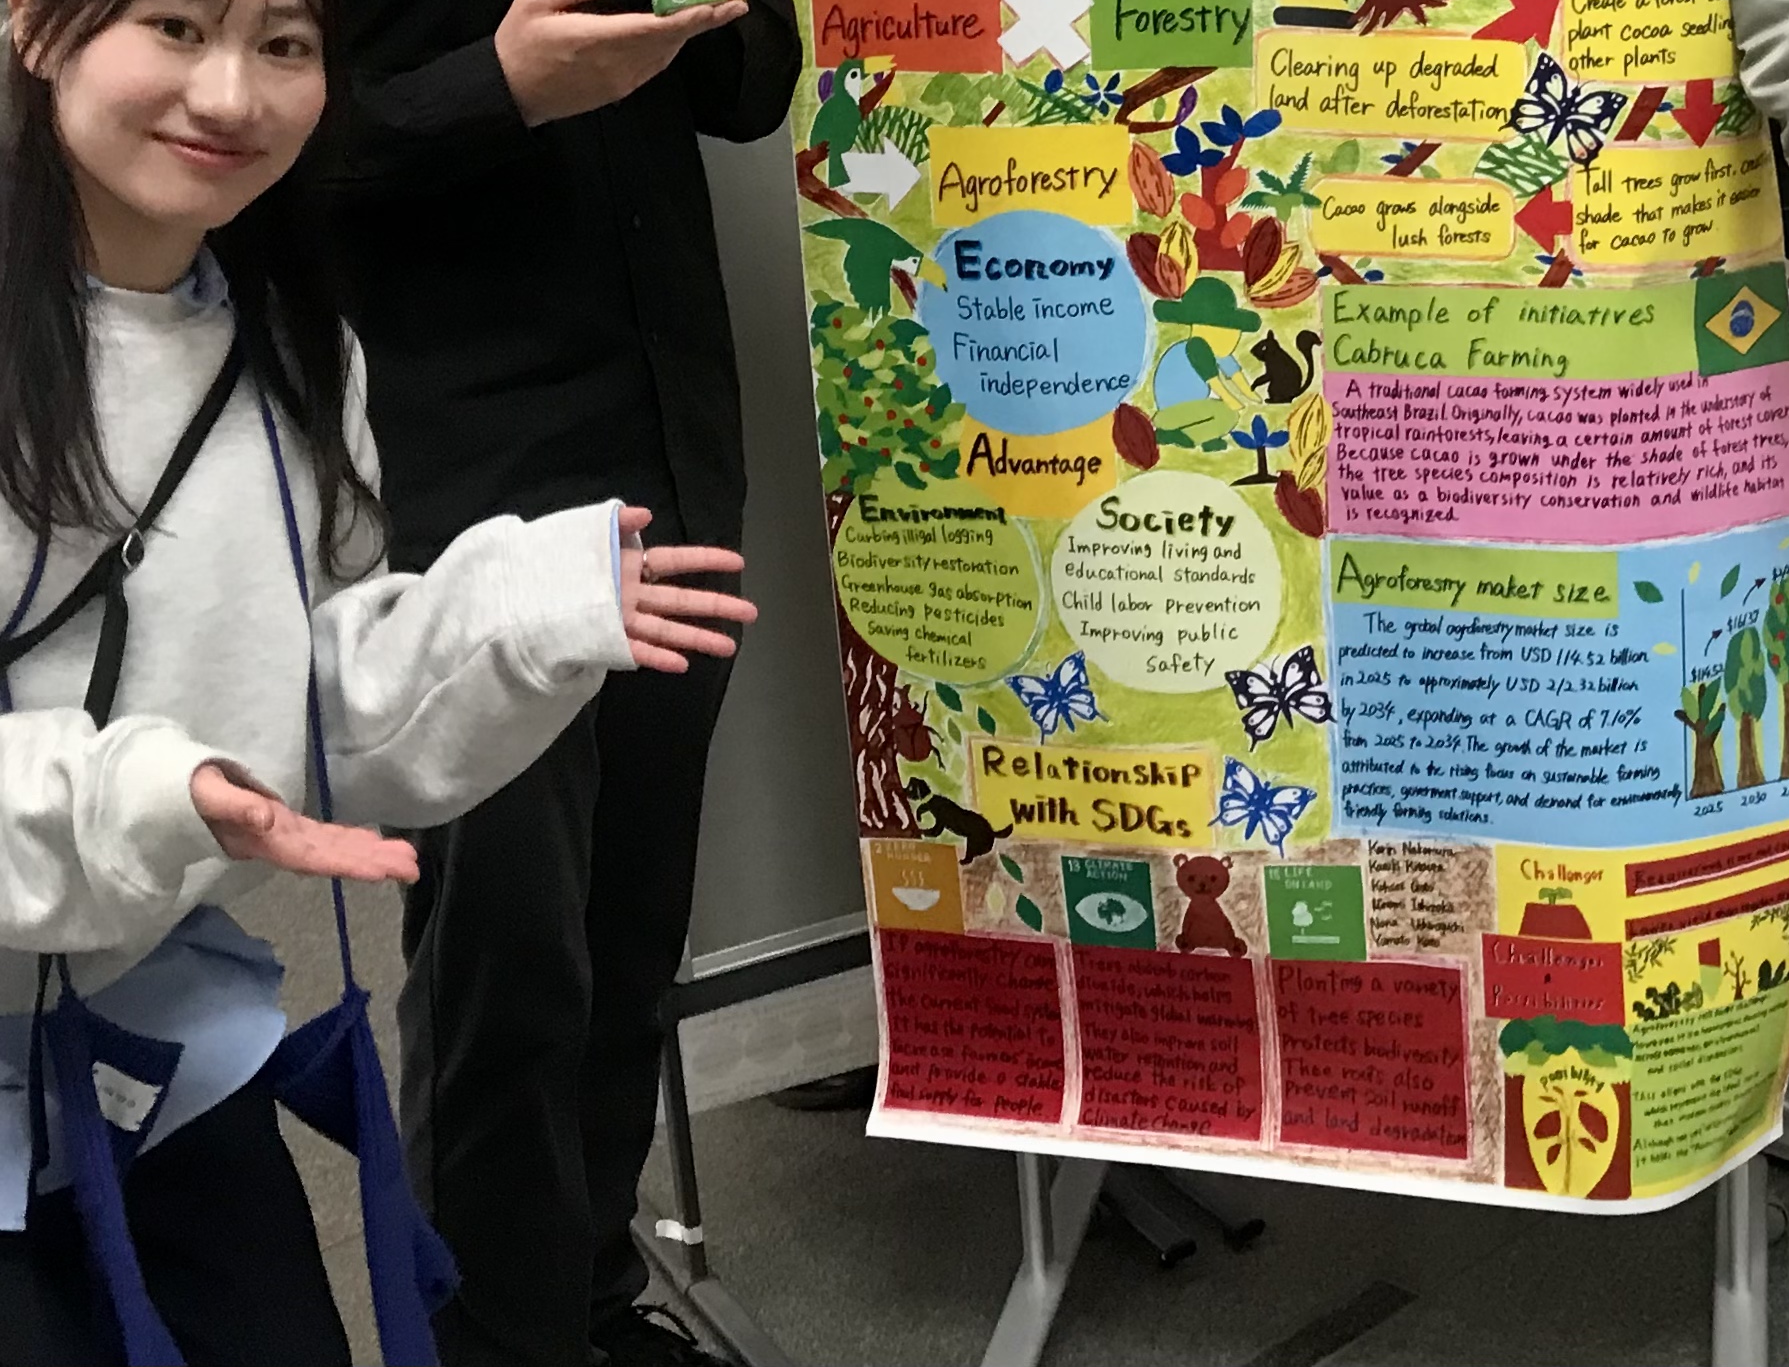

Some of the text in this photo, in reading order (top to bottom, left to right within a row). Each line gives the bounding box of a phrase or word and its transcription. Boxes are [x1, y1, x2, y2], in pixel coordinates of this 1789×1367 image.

[821, 3, 984, 58] Agriculture
[1569, 18, 1612, 51] plant
[1620, 24, 1673, 42] cocoa
[1270, 47, 1499, 92] Clearing up degraded
[1569, 45, 1676, 76] other plants
[1269, 83, 1508, 122] land after deforestation
[938, 157, 1118, 213] Agroforestry
[1576, 167, 1701, 197] Tall trees grow
[1323, 192, 1501, 231] Cacao grows alongside
[1576, 194, 1712, 225] shade that makes
[1392, 224, 1490, 249] lush forests
[1578, 229, 1656, 254] for cacao
[954, 239, 1115, 282] Economy
[957, 294, 1115, 322] Stable income
[1333, 289, 1655, 332] Example of initiatives
[953, 332, 1059, 363] Financial
[1333, 333, 1569, 378] Cabruca Farming
[980, 372, 1130, 398] independence
[1369, 371, 1693, 407] traditional cacao system widely used
[1332, 401, 1696, 426] Southeast Originally, cacao was planted the
[1334, 414, 1753, 446] tropical rainforests, leaving certain amount forest
[966, 432, 1102, 486] Advantage
[1336, 438, 1748, 470] Because cacao grown under the shade forest
[1338, 456, 1755, 488] the tree species composition and
[1341, 481, 1739, 509] value as biodiversity conservation and wildlife
[1096, 496, 1234, 537] Society
[1366, 507, 1460, 525] recognized
[845, 526, 900, 545] Curbing
[942, 526, 994, 545] logging
[1068, 536, 1242, 562] Improving living and
[934, 556, 1019, 575] restoration
[1065, 561, 1255, 584] educational standards
[1337, 552, 1467, 607] Agroforestry
[1553, 581, 1611, 604] size
[841, 575, 1033, 611] Greenhouse gas absorption
[1062, 589, 1153, 612] Child labor
[850, 597, 915, 619] Reducing
[868, 620, 972, 647] Saving chemical
[1080, 621, 1239, 647] Improving public
[1364, 612, 1595, 639] The market size
[1338, 643, 1552, 665] predicted increase from USD
[1356, 671, 1392, 685] 2025
[982, 745, 1202, 788] Relationship
[1341, 757, 1404, 773] attributed
[1694, 802, 1724, 817] 2025
[1740, 791, 1768, 808] 2030
[1010, 794, 1192, 838] with SDGs
[1068, 859, 1134, 872] 13 CLIMATE
[1085, 870, 1128, 883] ACTION
[1284, 868, 1312, 878] LIFE
